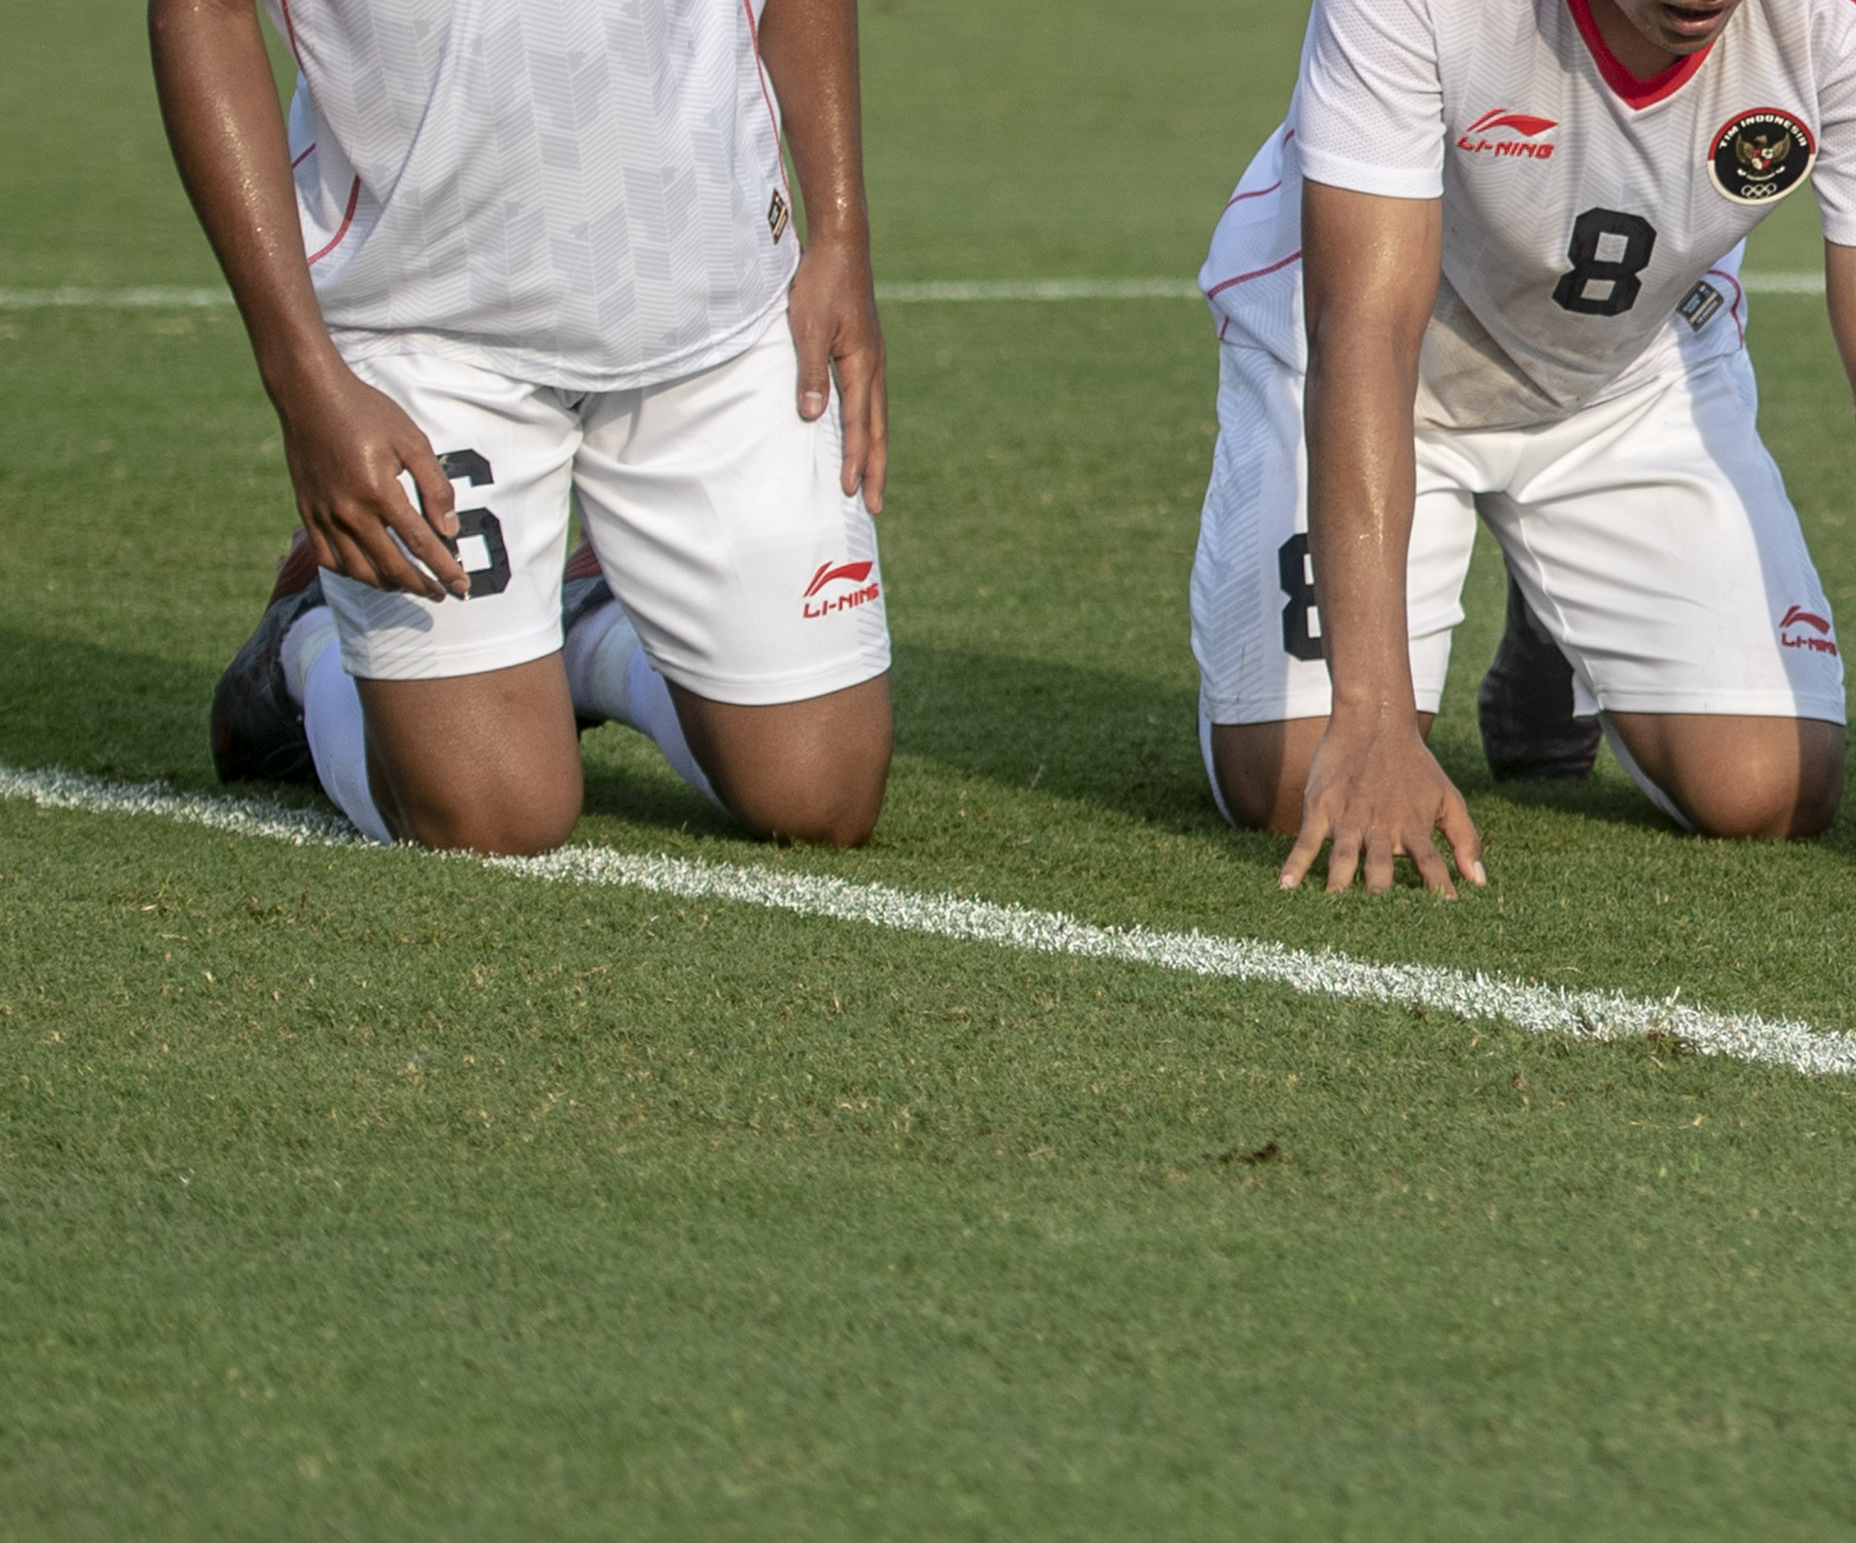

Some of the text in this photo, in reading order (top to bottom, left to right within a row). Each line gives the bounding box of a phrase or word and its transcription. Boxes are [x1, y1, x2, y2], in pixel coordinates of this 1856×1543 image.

[1456, 135, 1555, 160] LI-NING
[1718, 114, 1808, 149] TIM INDONESIA
[1551, 206, 1658, 317] 8
